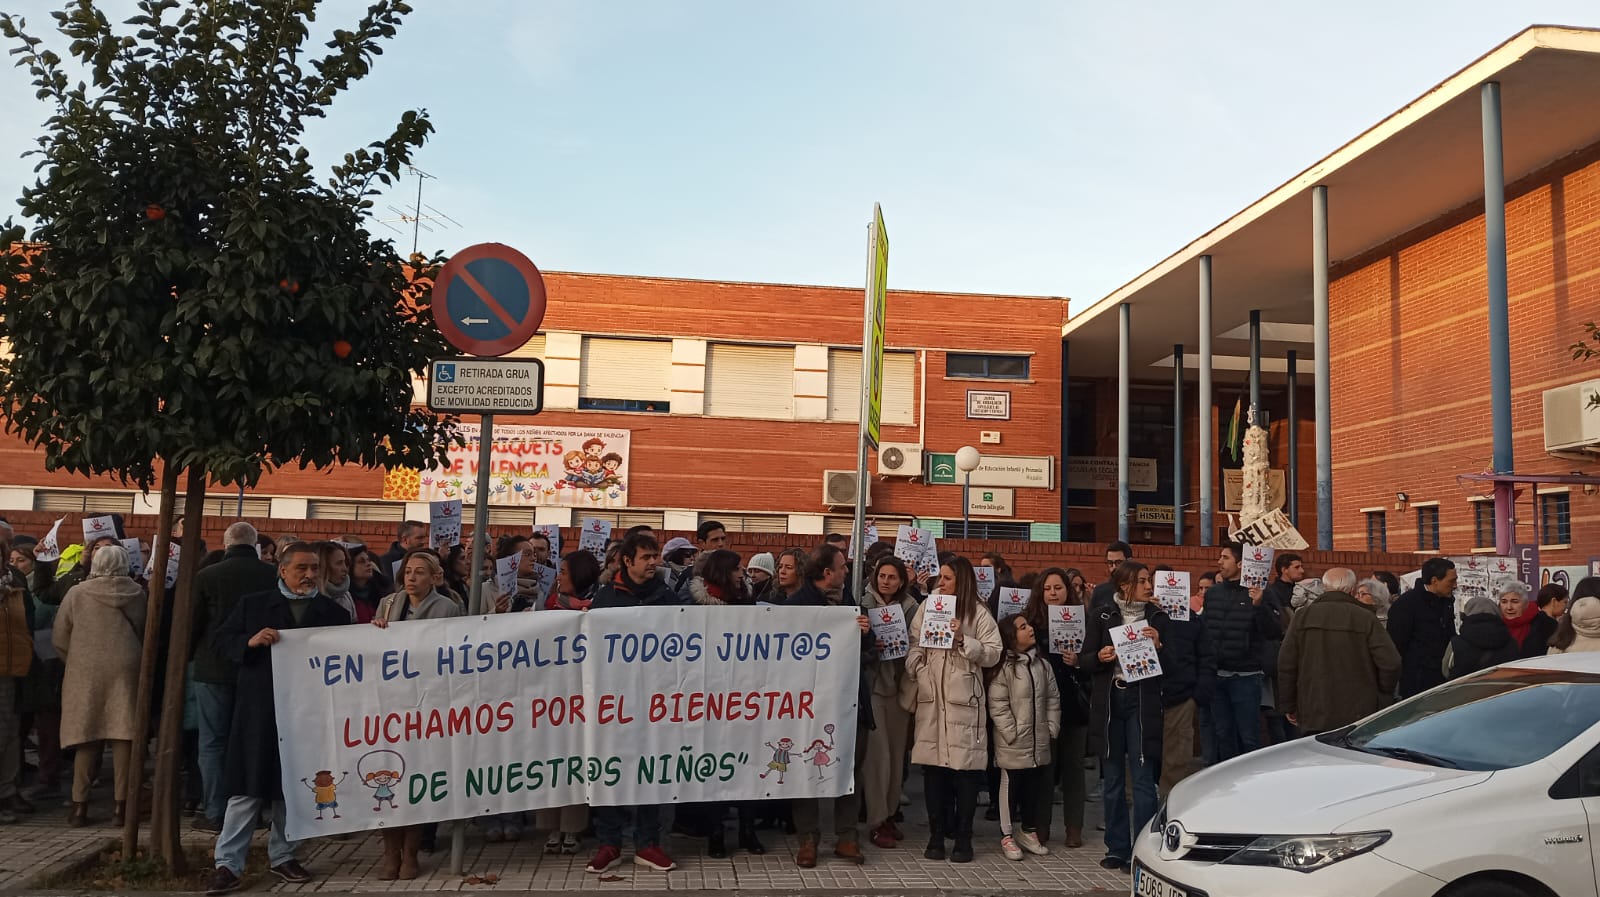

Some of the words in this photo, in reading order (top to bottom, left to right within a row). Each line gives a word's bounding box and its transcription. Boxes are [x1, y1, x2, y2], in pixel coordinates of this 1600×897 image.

[460, 368, 503, 378] RETIRADA
[505, 369, 530, 379] GRUA
[437, 385, 475, 395] EXCEPTO
[476, 386, 532, 396] ACREDITADOS
[434, 397, 445, 406] DE
[448, 397, 491, 407] MOVILIDAD
[493, 398, 533, 408] REDUCIDA
[442, 458, 464, 477] DE
[470, 459, 549, 479] VLENCIA
[1139, 512, 1175, 521] HISPALI
[382, 649, 420, 680] EL
[437, 634, 588, 676] HÍSPALIS
[604, 632, 702, 663] TOD@S
[717, 632, 832, 662] JUNT@S
[343, 701, 515, 749] LUCHAMOS
[531, 695, 586, 729] POR
[598, 694, 634, 725] EL
[648, 691, 815, 723] BIENESTAR
[408, 771, 448, 805] DE
[465, 755, 622, 798] NUESTR@S
